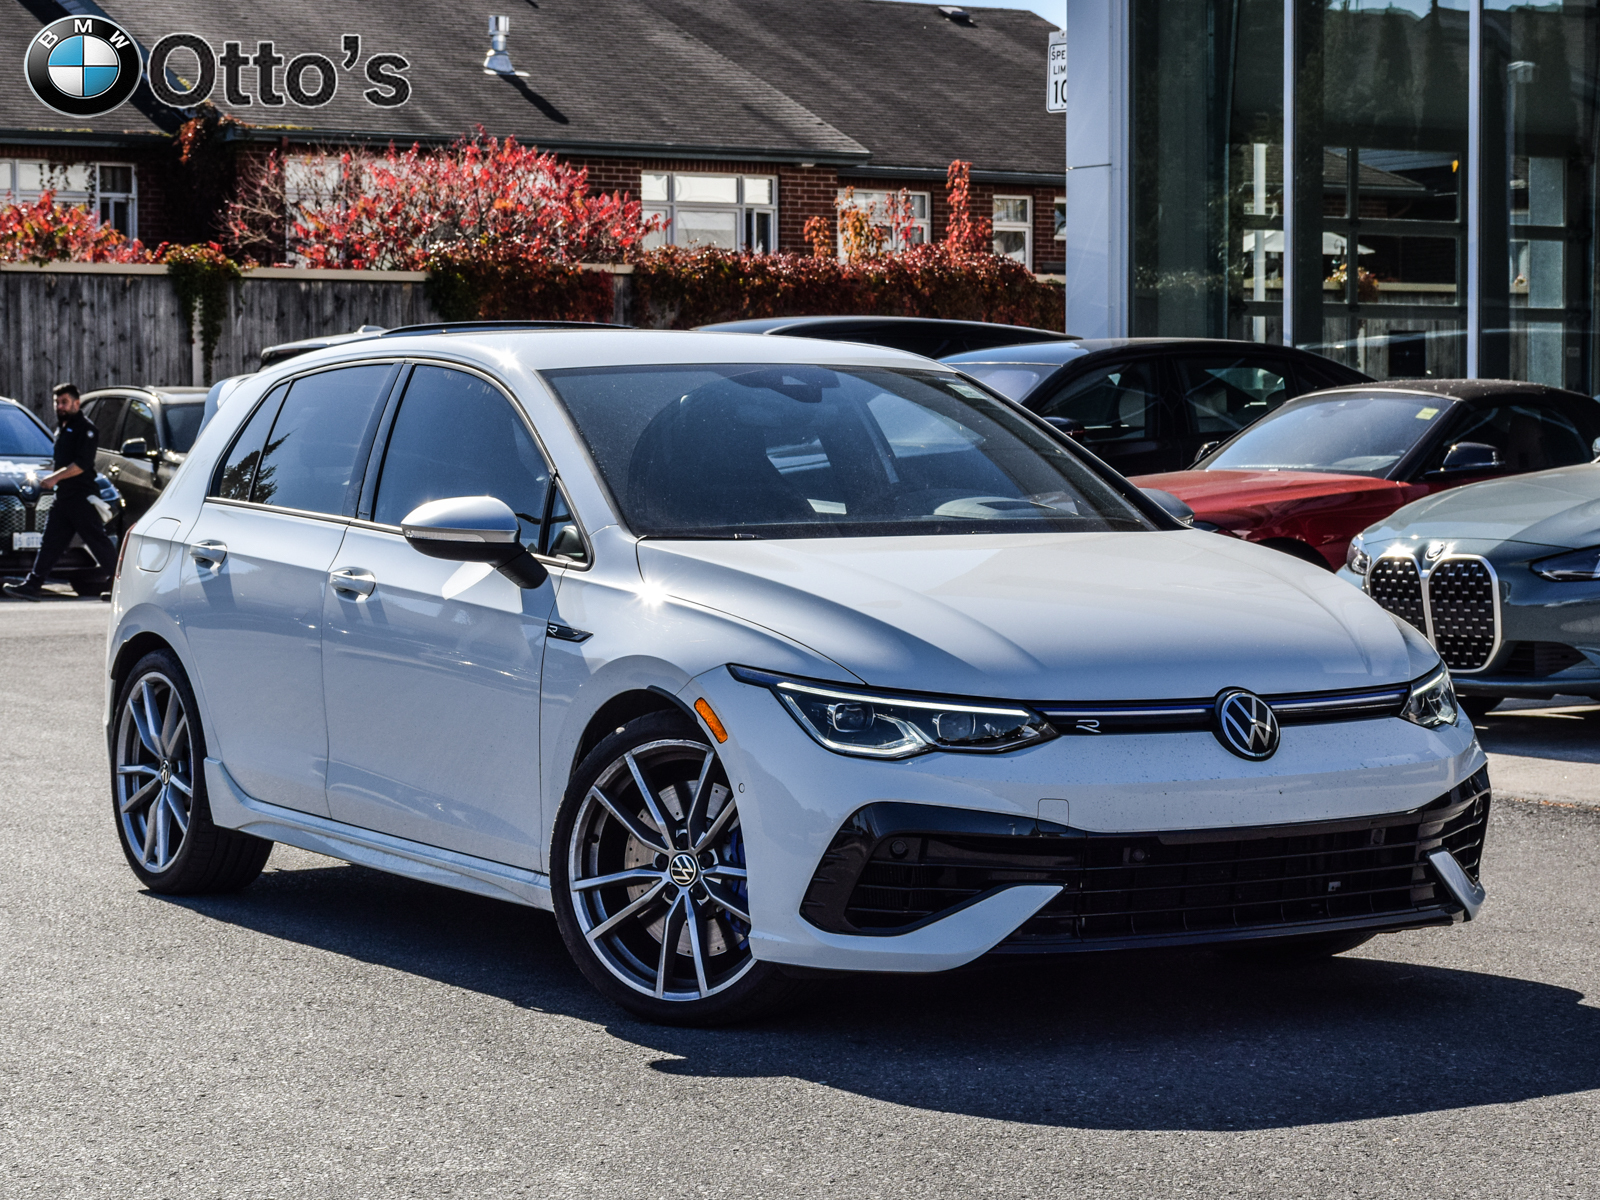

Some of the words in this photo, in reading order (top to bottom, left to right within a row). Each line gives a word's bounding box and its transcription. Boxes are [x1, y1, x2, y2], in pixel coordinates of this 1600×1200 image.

[1051, 50, 1066, 61] SPE
[1053, 65, 1066, 75] LIM
[1076, 719, 1102, 733] R
